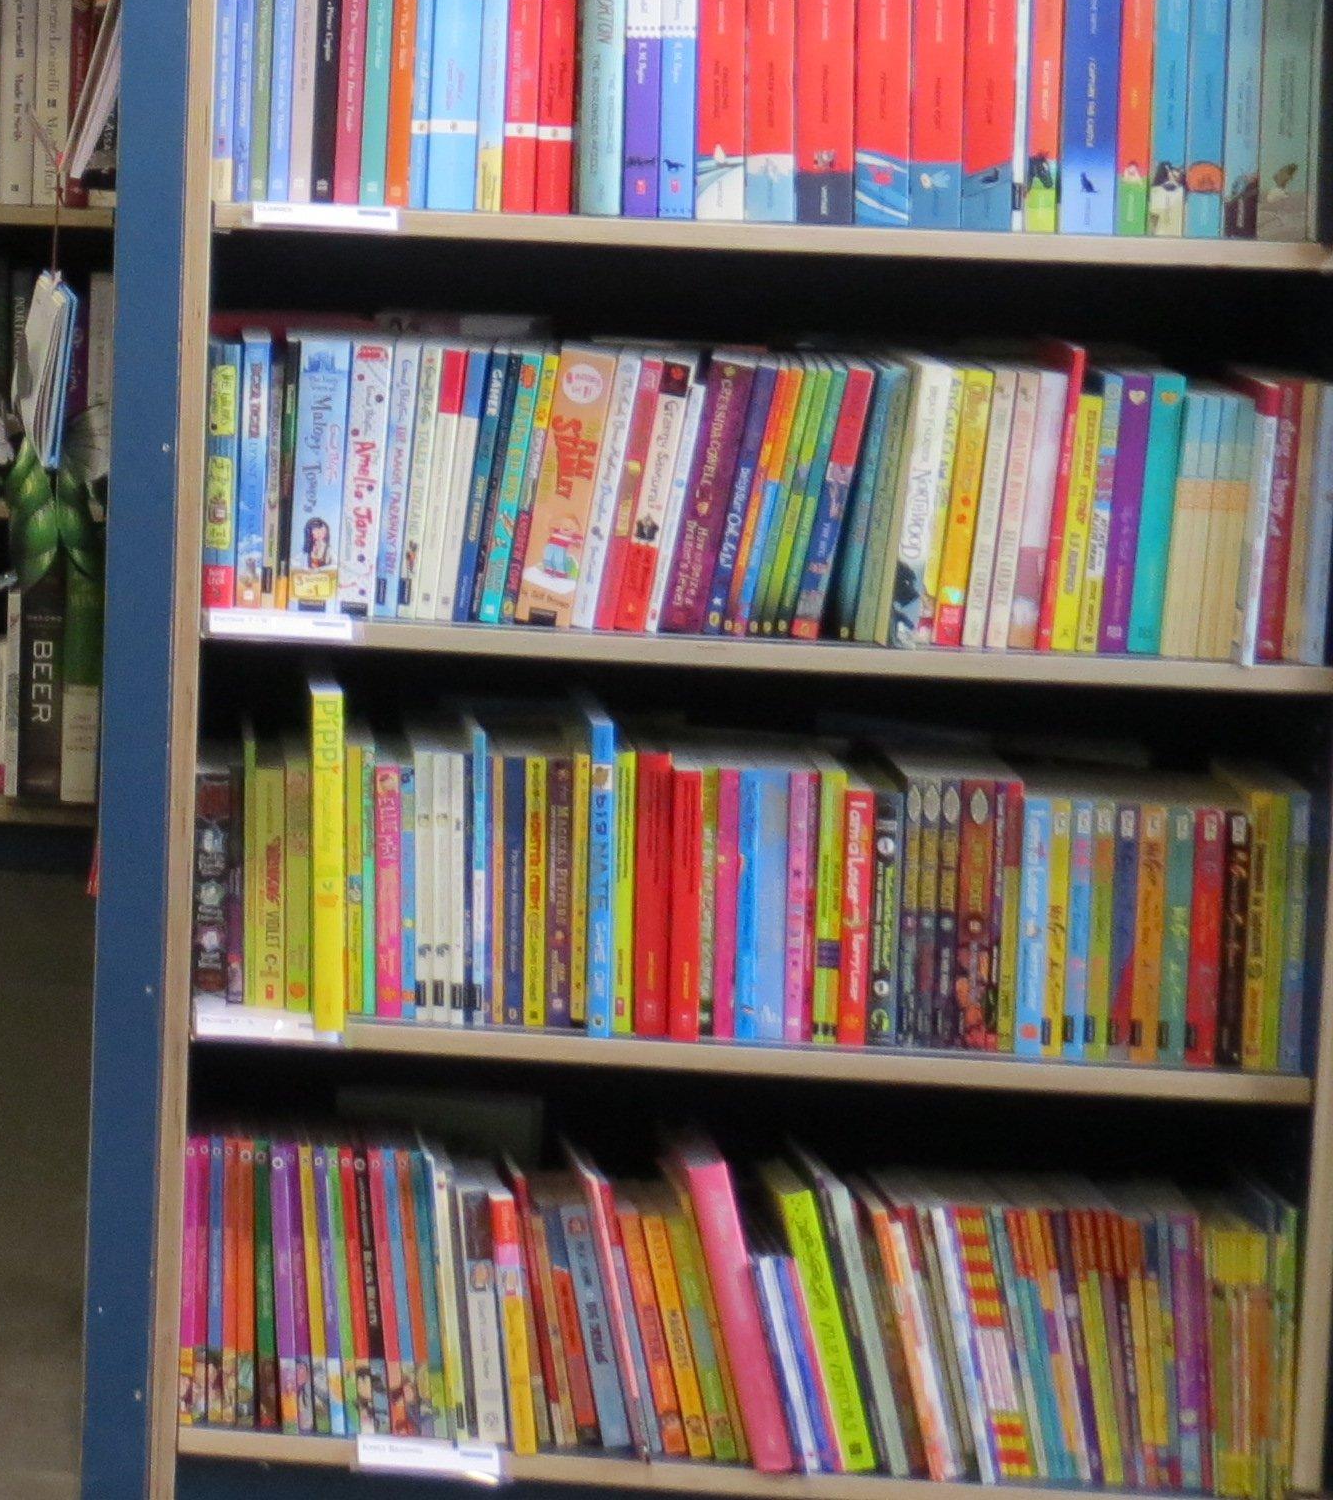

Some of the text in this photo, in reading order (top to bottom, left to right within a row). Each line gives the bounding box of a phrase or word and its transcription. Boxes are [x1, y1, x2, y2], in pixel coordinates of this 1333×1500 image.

[486, 368, 504, 417] GAMER
[301, 394, 332, 514] Malory Towers
[352, 440, 378, 548] Amelia Jane
[646, 400, 680, 510] Granny Samurai
[30, 639, 54, 725] BEER
[315, 697, 342, 775] Pippi
